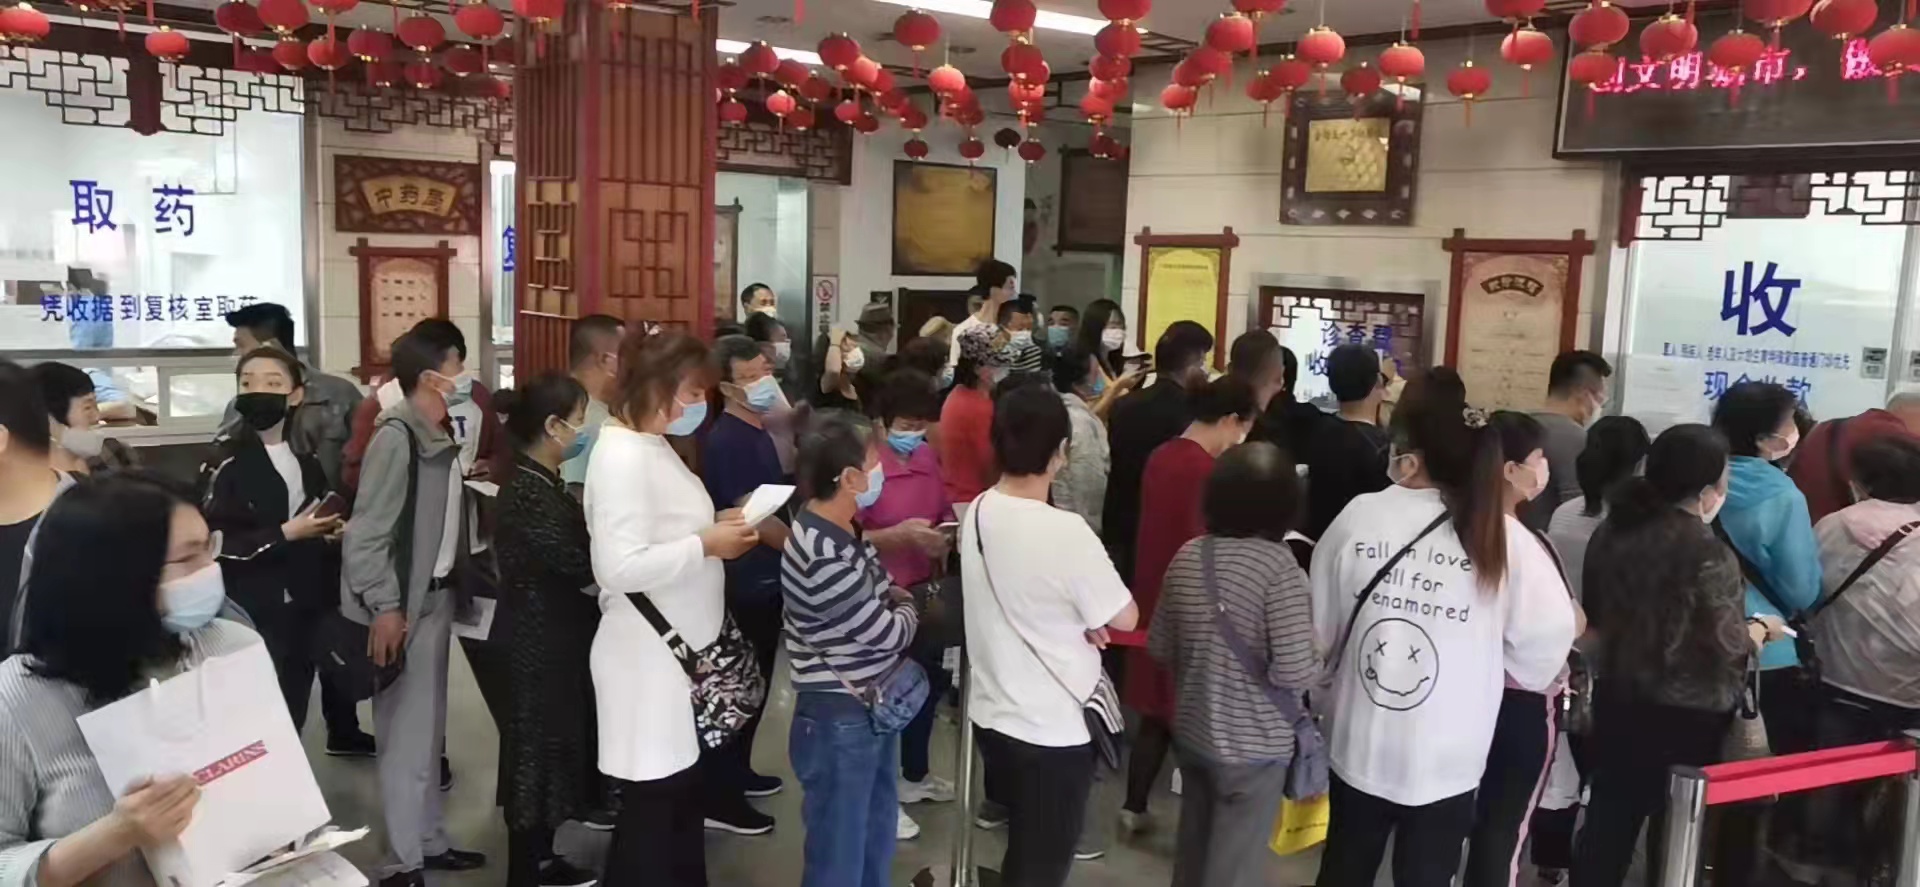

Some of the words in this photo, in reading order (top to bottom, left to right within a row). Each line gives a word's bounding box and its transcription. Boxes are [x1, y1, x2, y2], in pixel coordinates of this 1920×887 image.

[69, 179, 194, 236] 取药
[1720, 260, 1801, 337] 收
[1704, 370, 1811, 401] 现款
[1355, 541, 1389, 559] Fall
[1427, 546, 1472, 572] love
[1379, 567, 1405, 587] all
[1411, 572, 1444, 593] for
